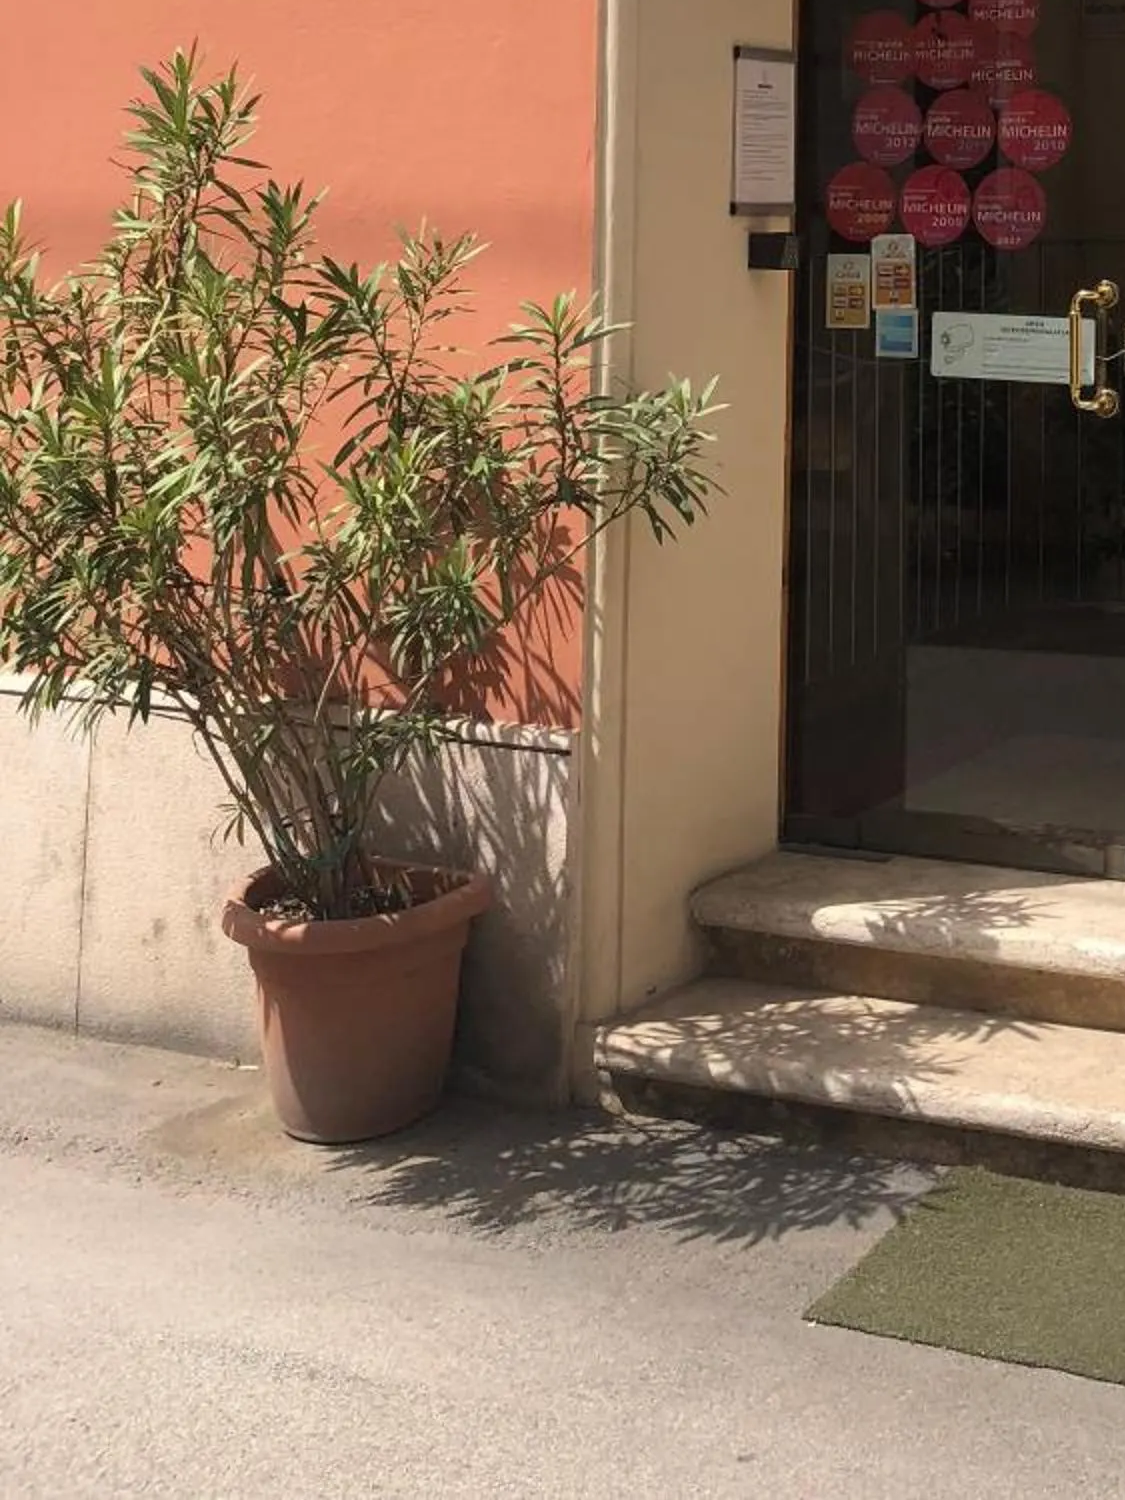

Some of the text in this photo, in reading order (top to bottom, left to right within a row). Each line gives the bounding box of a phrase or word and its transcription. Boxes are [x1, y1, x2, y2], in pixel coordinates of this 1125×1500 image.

[974, 6, 1036, 20] MICHELIN
[971, 68, 1033, 81] MICHELIN
[855, 121, 918, 135] MICHELIN
[927, 125, 991, 139] MICHELIN
[1001, 124, 1066, 138] MICHELIN
[829, 199, 892, 211] MICHELIN
[903, 203, 967, 214] MICHELIN
[978, 211, 1040, 223] MICHELIN
